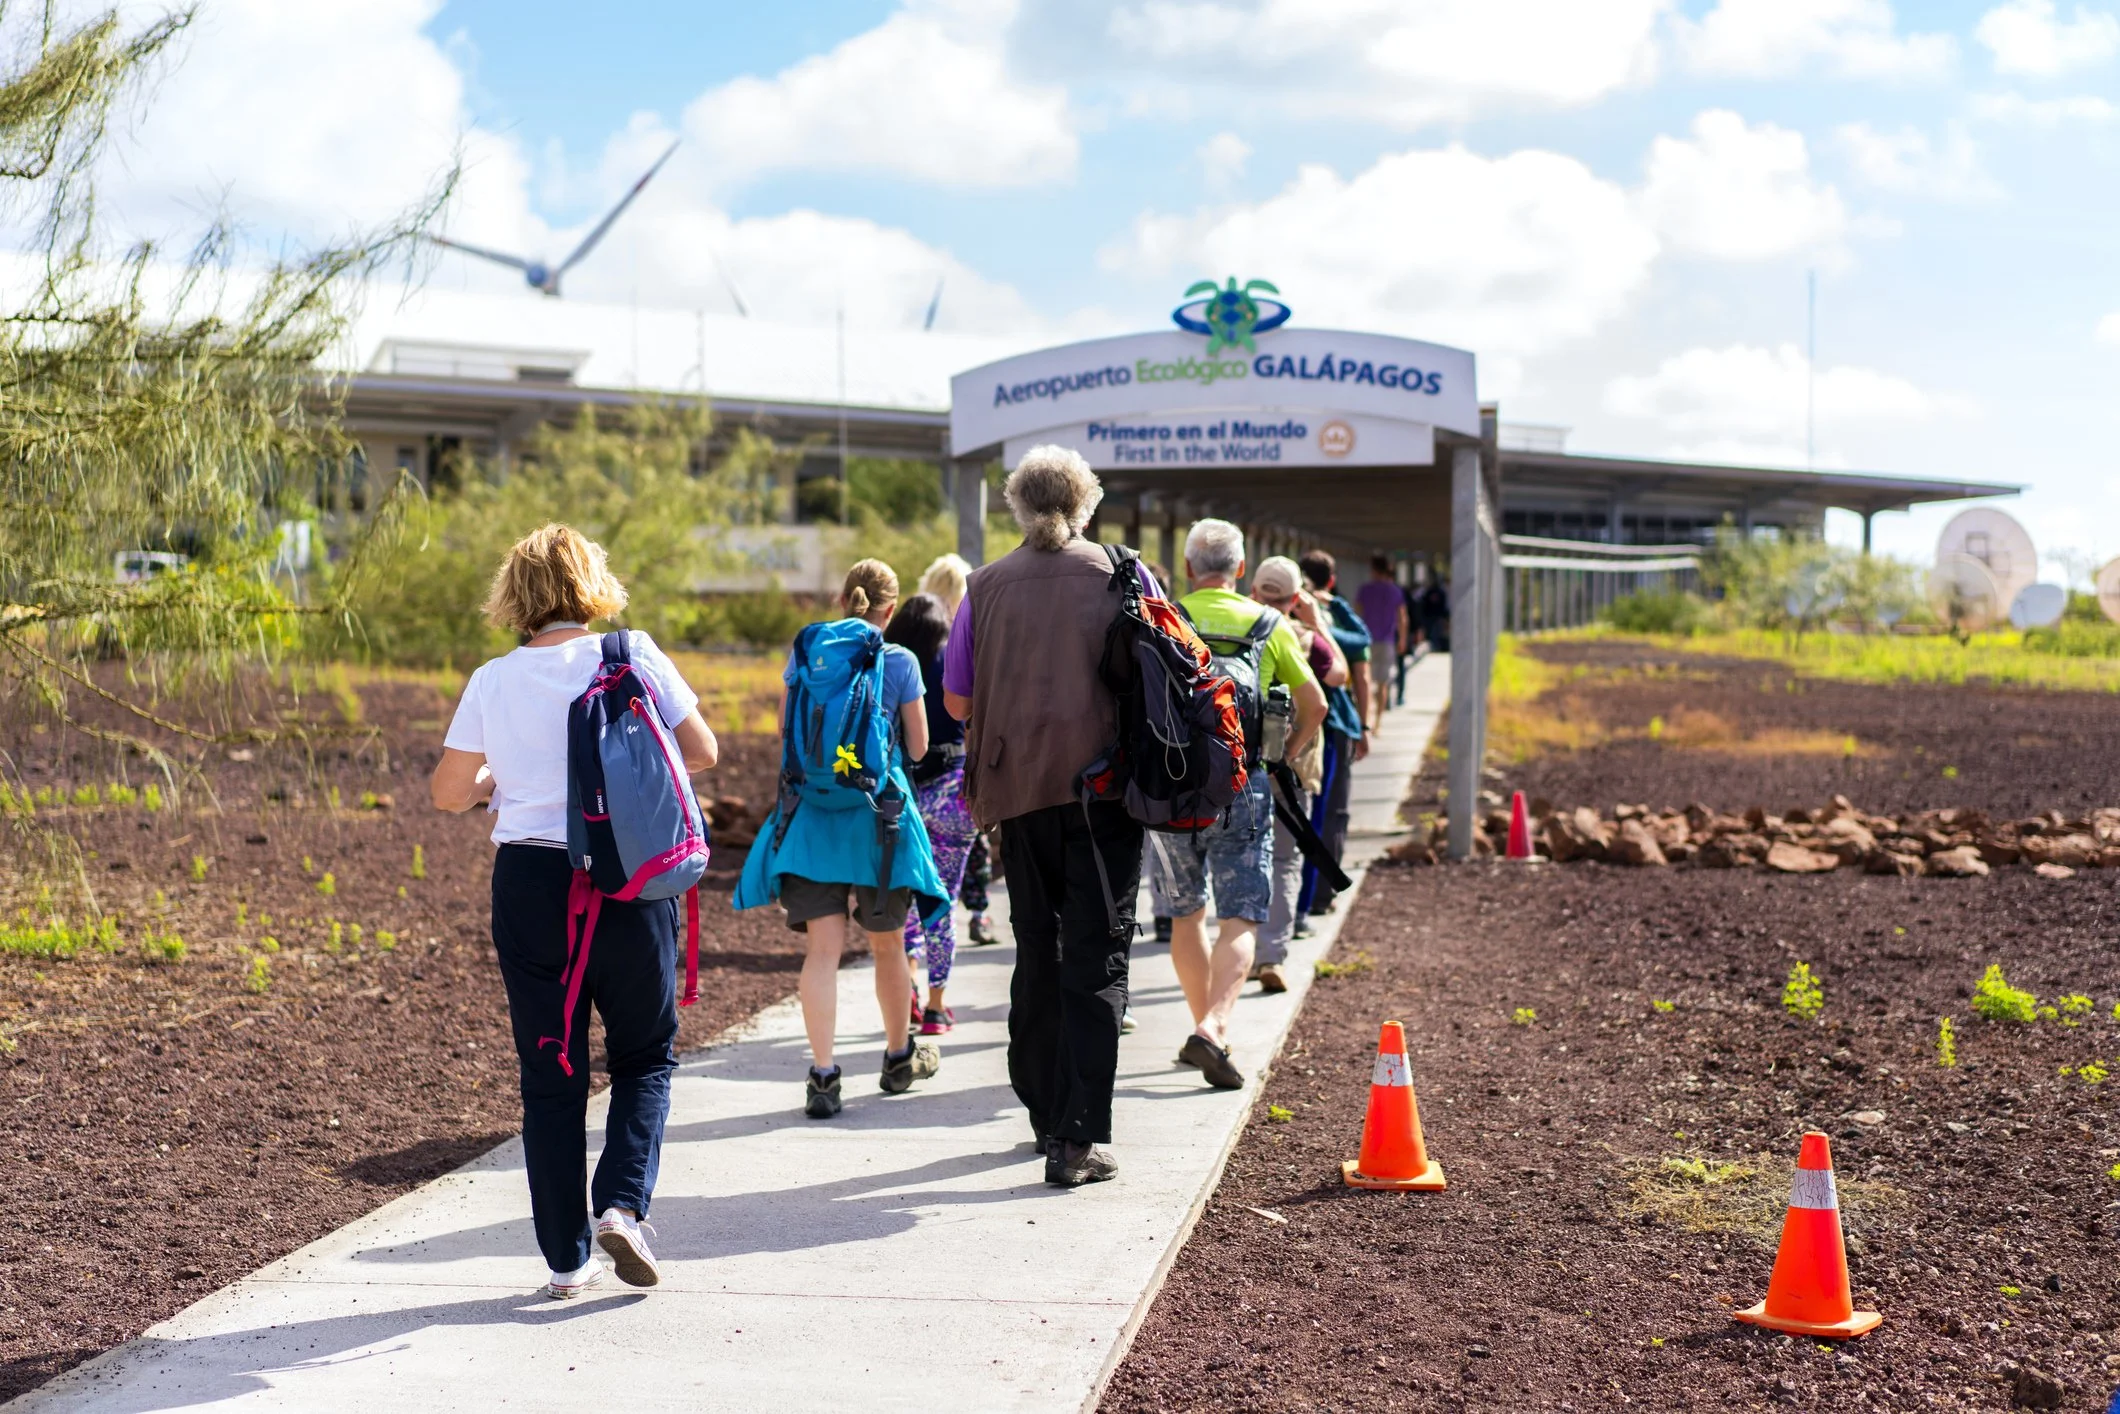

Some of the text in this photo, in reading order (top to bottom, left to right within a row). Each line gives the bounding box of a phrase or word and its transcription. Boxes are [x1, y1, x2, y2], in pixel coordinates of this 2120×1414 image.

[993, 353, 1443, 408] Aeropuerto Ecológico GALÁPAGOS
[1088, 420, 1307, 441] Primero en el Mundo
[1114, 442, 1281, 463] First in the World
